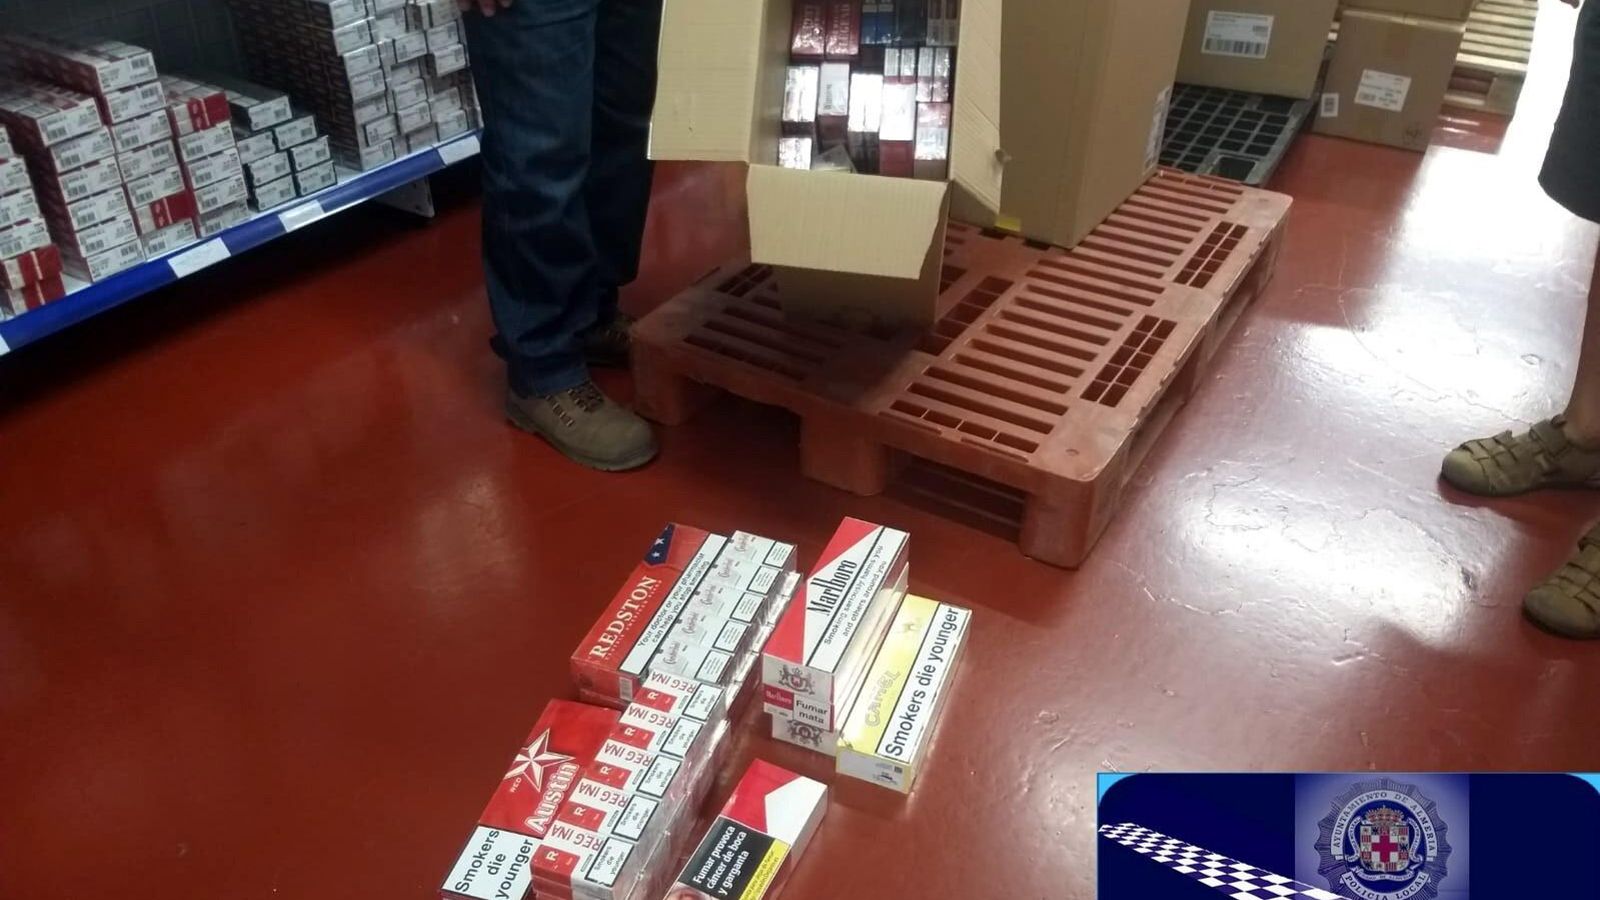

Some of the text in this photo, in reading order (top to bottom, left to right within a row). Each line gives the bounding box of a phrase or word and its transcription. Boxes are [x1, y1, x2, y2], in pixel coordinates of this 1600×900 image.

[589, 576, 657, 658] REDSTON
[807, 560, 857, 616] Marlboro
[824, 545, 884, 644] Smoking seriously harms you
[843, 561, 887, 637] and others around you
[638, 631, 652, 647] Your
[652, 608, 667, 630] doctor
[662, 614, 674, 632] help
[796, 700, 827, 714] Fumar
[885, 690, 926, 756] Smokers
[916, 664, 936, 686] die
[928, 608, 959, 662] younger
[799, 711, 824, 724] mata
[524, 762, 580, 834] Austin
[455, 830, 500, 892] Smokers
[487, 854, 506, 875] die
[495, 839, 534, 900] younger
[693, 826, 736, 884] Fumar provoca
[706, 831, 747, 889] cáncer de boca
[718, 850, 750, 896] y garganta
